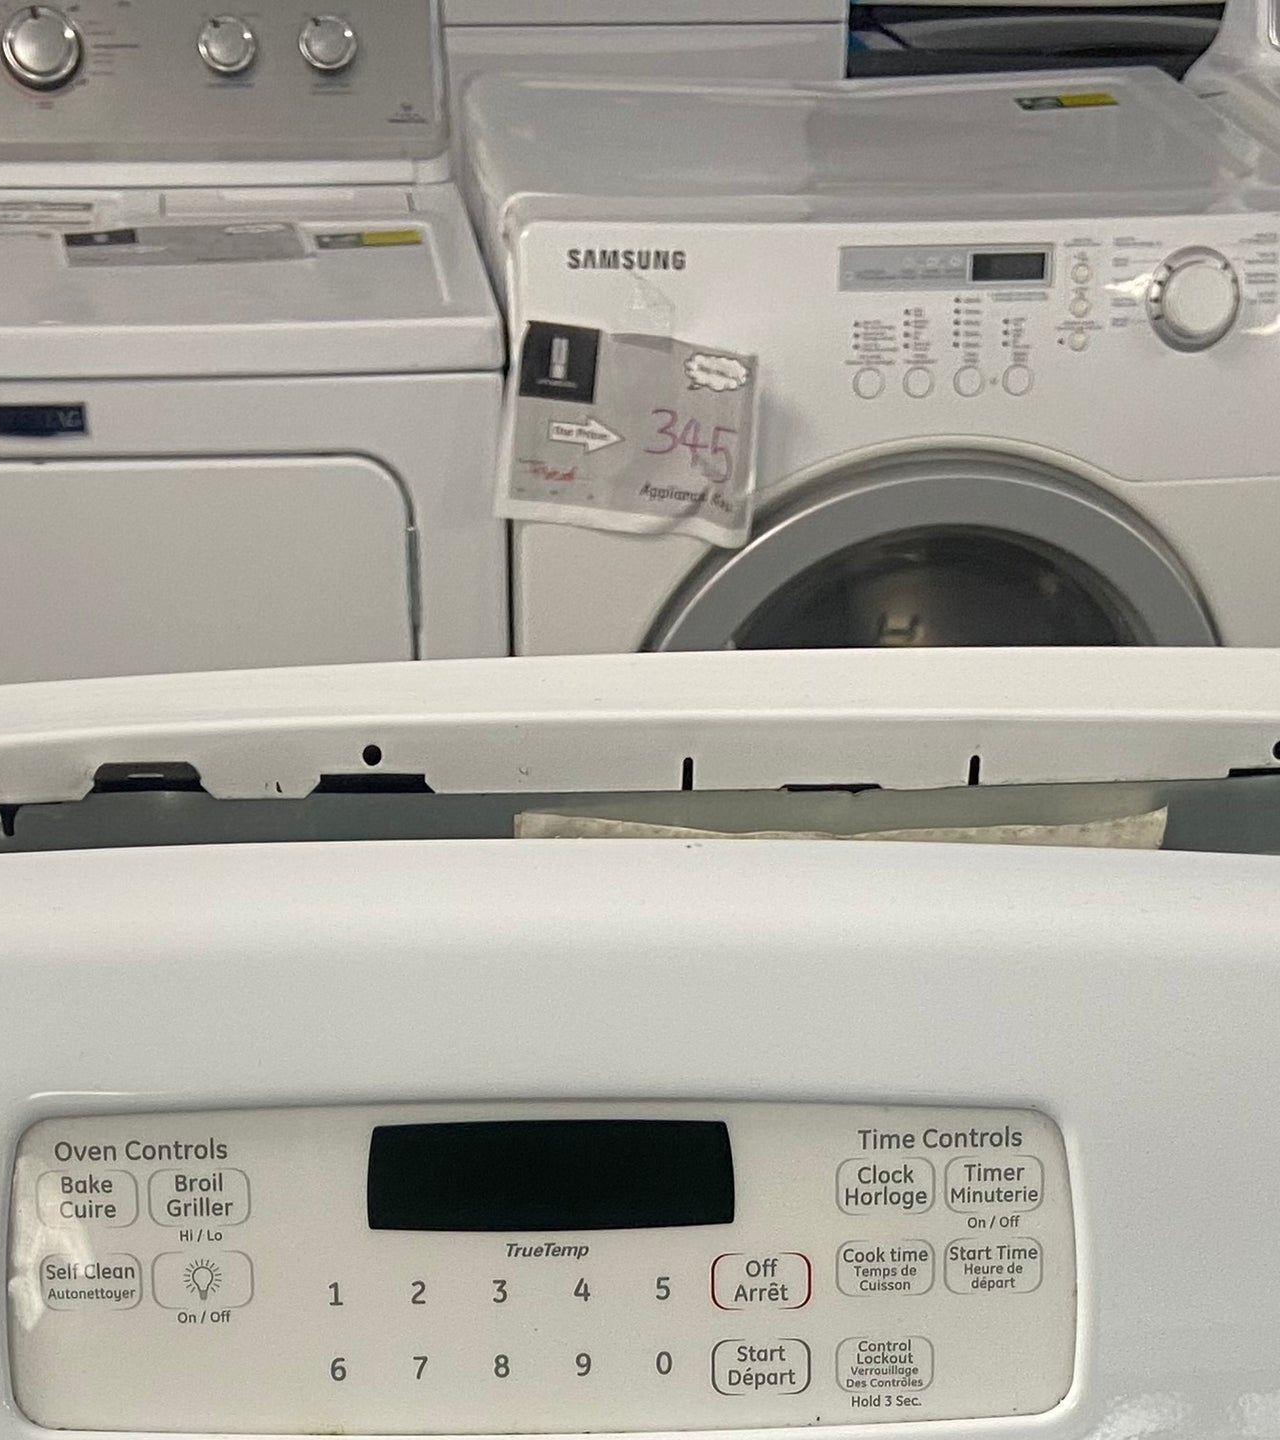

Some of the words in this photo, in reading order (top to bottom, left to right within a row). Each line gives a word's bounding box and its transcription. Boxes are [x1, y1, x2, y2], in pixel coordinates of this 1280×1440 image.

[567, 248, 686, 271] SAMSUNG
[643, 409, 739, 484] 345
[857, 1128, 916, 1150] Time
[922, 1125, 1023, 1149] Controls
[54, 1141, 117, 1162] Oven
[125, 1136, 228, 1161] Controls
[857, 1163, 914, 1185] Clock
[963, 1162, 1026, 1183] Timer
[60, 1173, 113, 1194] Bake
[174, 1172, 223, 1193] Broil
[845, 1185, 928, 1210] Horloge
[950, 1185, 1039, 1204] Minuterie
[60, 1199, 117, 1219] Cuire
[166, 1197, 234, 1218] Griller
[967, 1216, 986, 1229] On
[989, 1215, 996, 1230] /
[999, 1214, 1021, 1228] Off
[179, 1229, 194, 1242] Hi
[196, 1228, 203, 1243] /
[206, 1229, 223, 1242] Lo
[505, 1242, 590, 1260] TrueTemp
[842, 1246, 886, 1264] Cook
[889, 1246, 929, 1263] time
[949, 1245, 993, 1261] Start
[996, 1244, 1038, 1260] Time
[45, 1263, 80, 1281] Self
[84, 1262, 135, 1280] Clean
[745, 1257, 779, 1278] Off
[853, 1265, 898, 1280] Temps
[900, 1264, 917, 1277] de
[964, 1263, 1004, 1275] Heure
[1006, 1261, 1023, 1275] de
[328, 1281, 344, 1307] 1
[411, 1280, 427, 1305] 2
[492, 1279, 508, 1304] 3
[573, 1277, 591, 1302] 4
[655, 1276, 671, 1301] 5
[733, 1282, 789, 1302] Arrêt
[859, 1279, 911, 1292] Cuisson
[971, 1275, 1016, 1292] départ
[47, 1287, 136, 1302] Autonettoyer
[177, 1311, 197, 1324] On
[200, 1310, 207, 1324] /
[209, 1309, 231, 1323] Off
[736, 1345, 786, 1363] Start
[857, 1338, 912, 1353] Control
[330, 1357, 347, 1382] 6
[412, 1355, 429, 1380] 7
[493, 1354, 510, 1379] 8
[575, 1352, 592, 1377] 9
[655, 1351, 673, 1376] 0
[856, 1351, 914, 1365] Lockout
[728, 1367, 796, 1390] Départ
[850, 1364, 919, 1377] Verrouillage
[846, 1378, 868, 1389] Des
[869, 1375, 924, 1388] Contrôles
[851, 1394, 881, 1408] Hold
[884, 1395, 893, 1407] 3
[895, 1395, 922, 1407] Sec.
